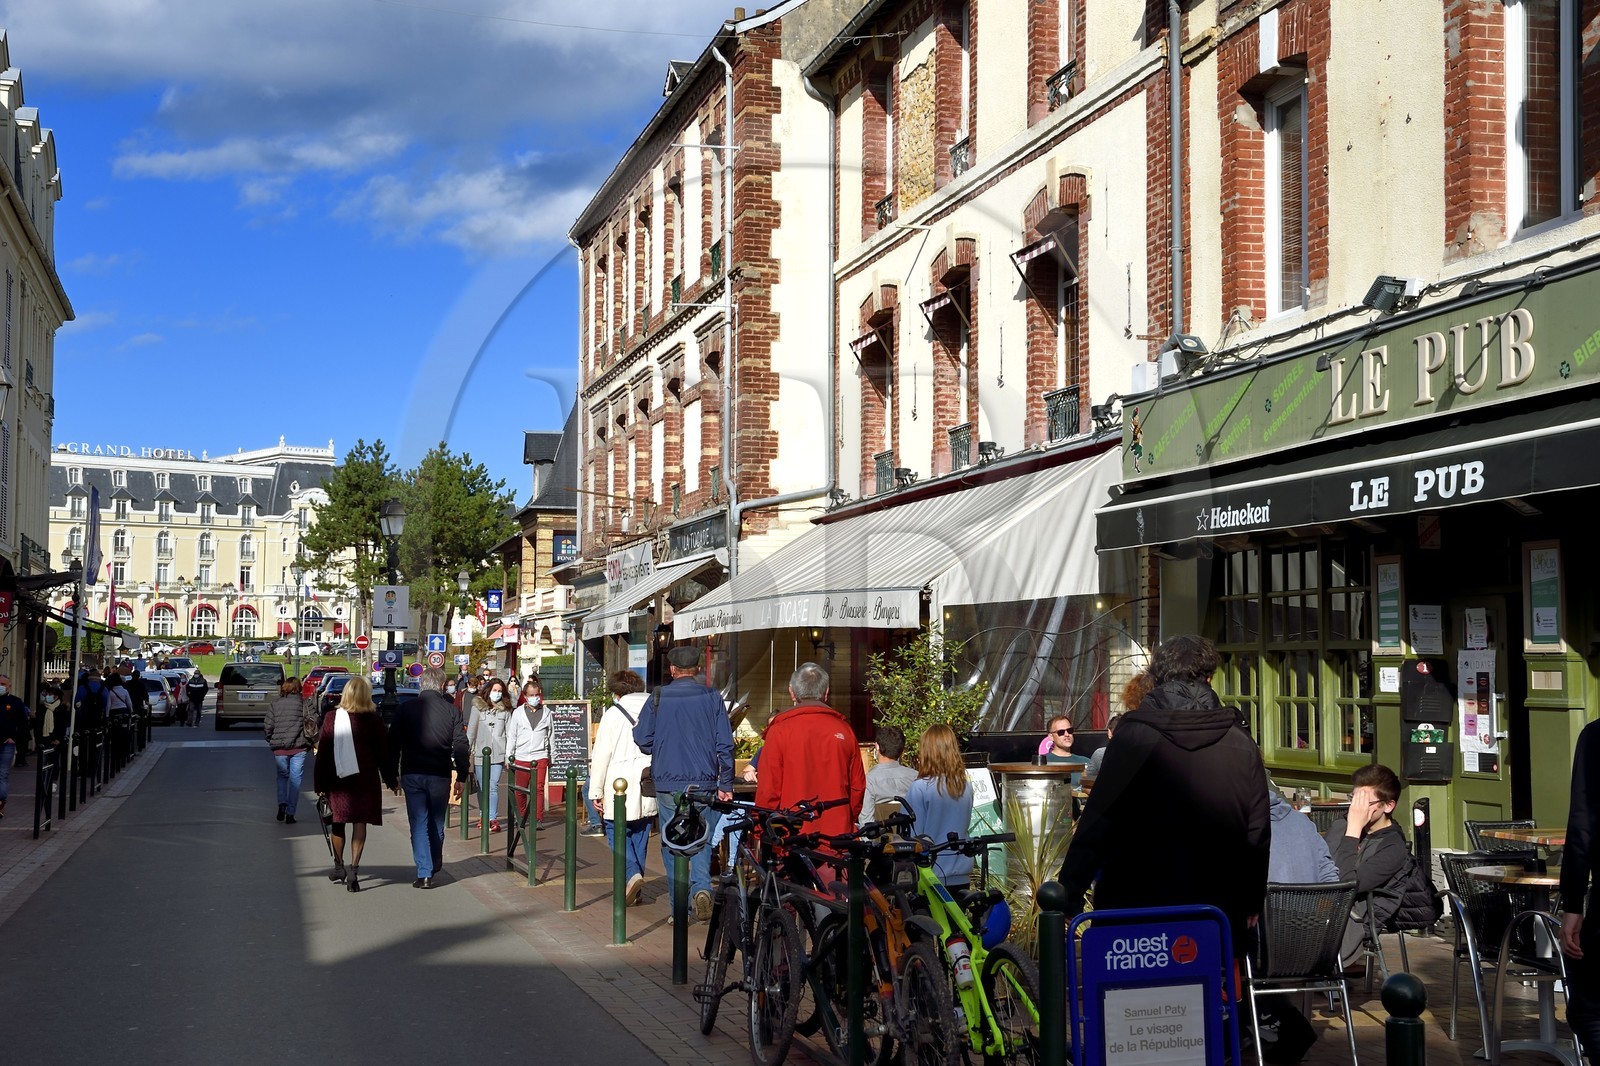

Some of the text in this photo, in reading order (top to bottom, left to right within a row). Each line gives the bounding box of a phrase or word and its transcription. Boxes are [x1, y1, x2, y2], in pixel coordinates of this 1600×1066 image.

[1328, 308, 1536, 427] LE PUB
[66, 442, 196, 460] GRAND HOTEL
[1350, 460, 1485, 512] LE PUB
[1210, 502, 1271, 530] Heineken
[431, 656, 441, 664] 30
[1422, 663, 1429, 673] 1
[1112, 933, 1169, 954] ouest
[1105, 950, 1169, 970] france
[1124, 1005, 1187, 1018] Samuel Paty
[1129, 1023, 1183, 1036] Le visage
[1109, 1036, 1204, 1054] de la République
